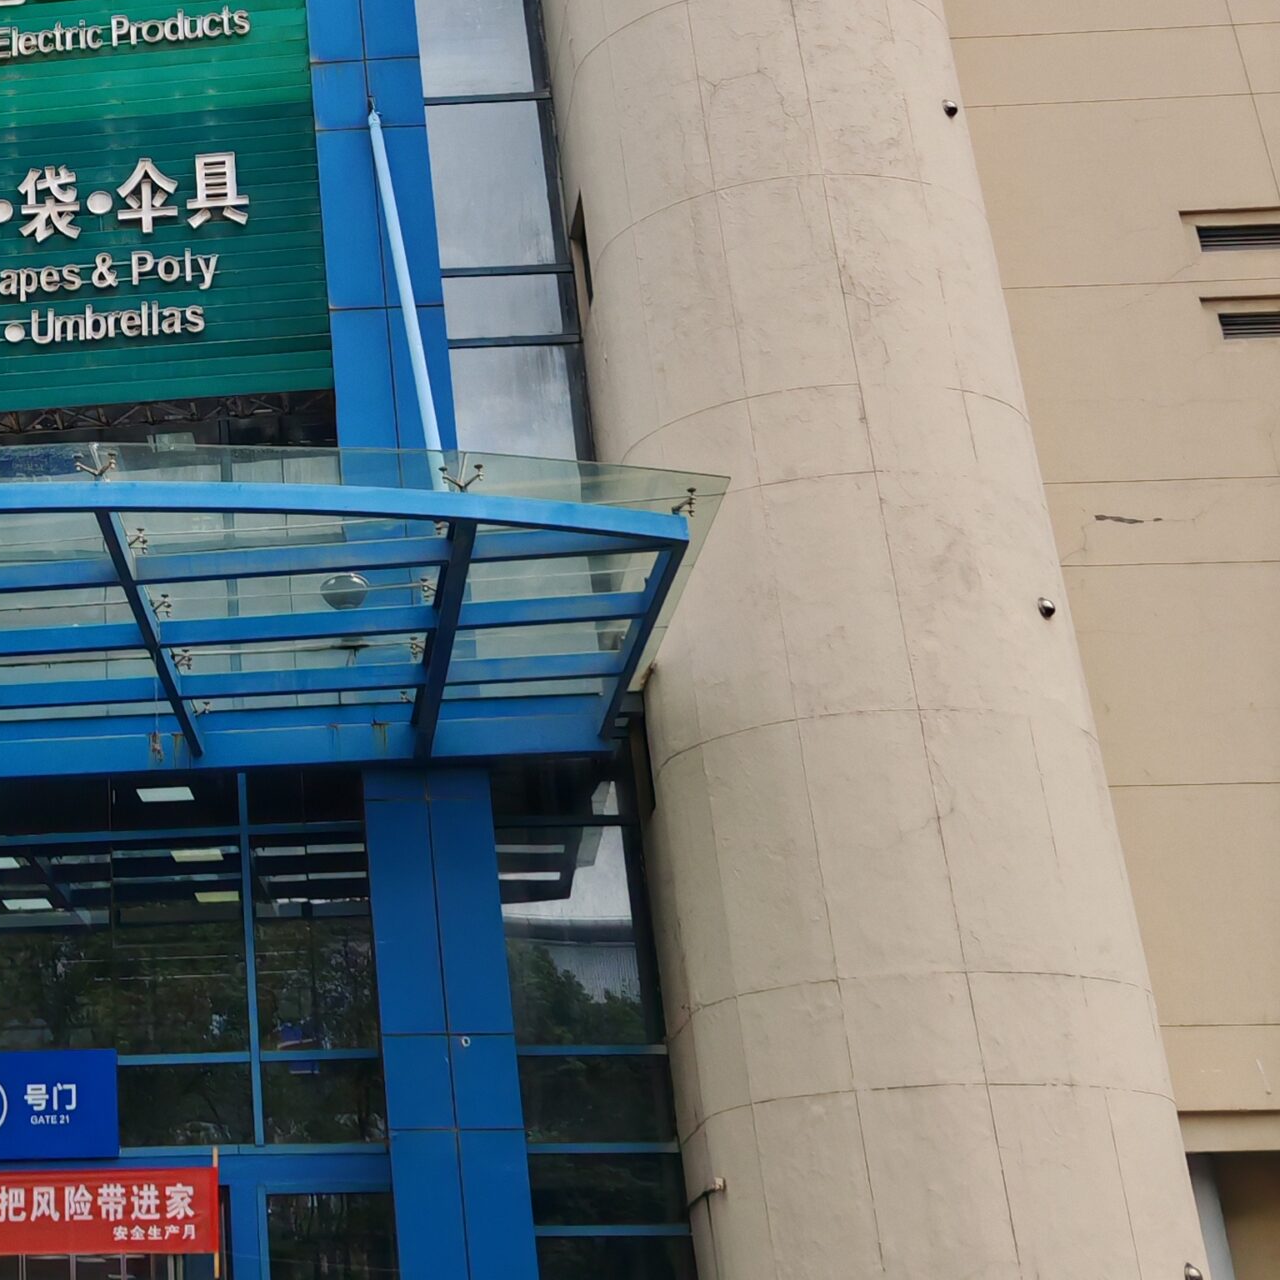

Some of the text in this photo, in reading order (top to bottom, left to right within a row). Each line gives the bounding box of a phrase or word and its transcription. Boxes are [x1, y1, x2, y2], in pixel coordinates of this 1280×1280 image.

[110, 5, 251, 47] Products
[91, 252, 118, 288] &
[130, 247, 219, 290] Poly
[24, 1083, 77, 1111] 号门
[30, 1114, 70, 1125] GATE 21
[113, 1224, 196, 1241] 安全生产月
